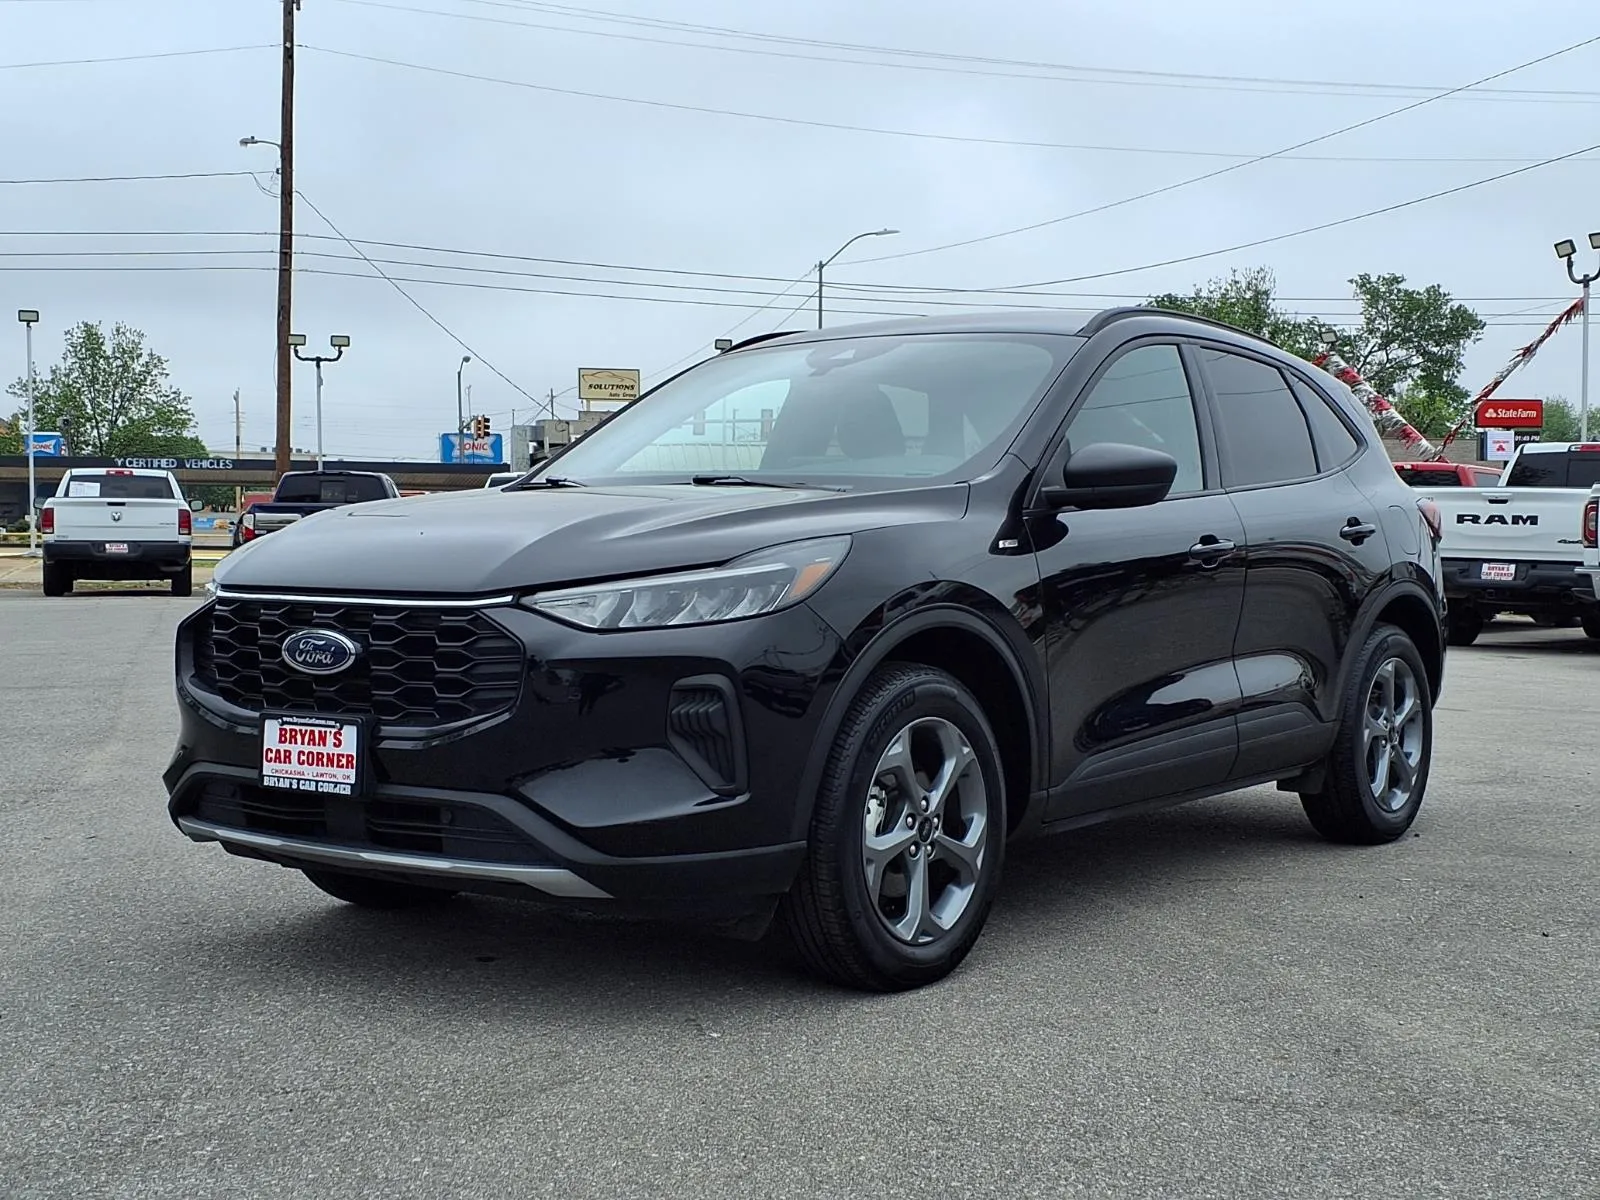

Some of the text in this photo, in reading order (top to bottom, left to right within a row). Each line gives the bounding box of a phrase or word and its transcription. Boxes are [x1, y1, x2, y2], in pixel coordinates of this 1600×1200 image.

[588, 383, 636, 391] SOLUTIONS
[126, 458, 178, 468] CERTIFIED
[185, 459, 233, 469] VEHICLES
[1457, 513, 1539, 526] RAM
[295, 638, 336, 664] Ford
[278, 727, 343, 748] BRYAN'S
[264, 747, 355, 770] CAR CORNER
[270, 768, 305, 777] CHICKASHA
[263, 775, 351, 795] BRYAN'S CAR CORNER
